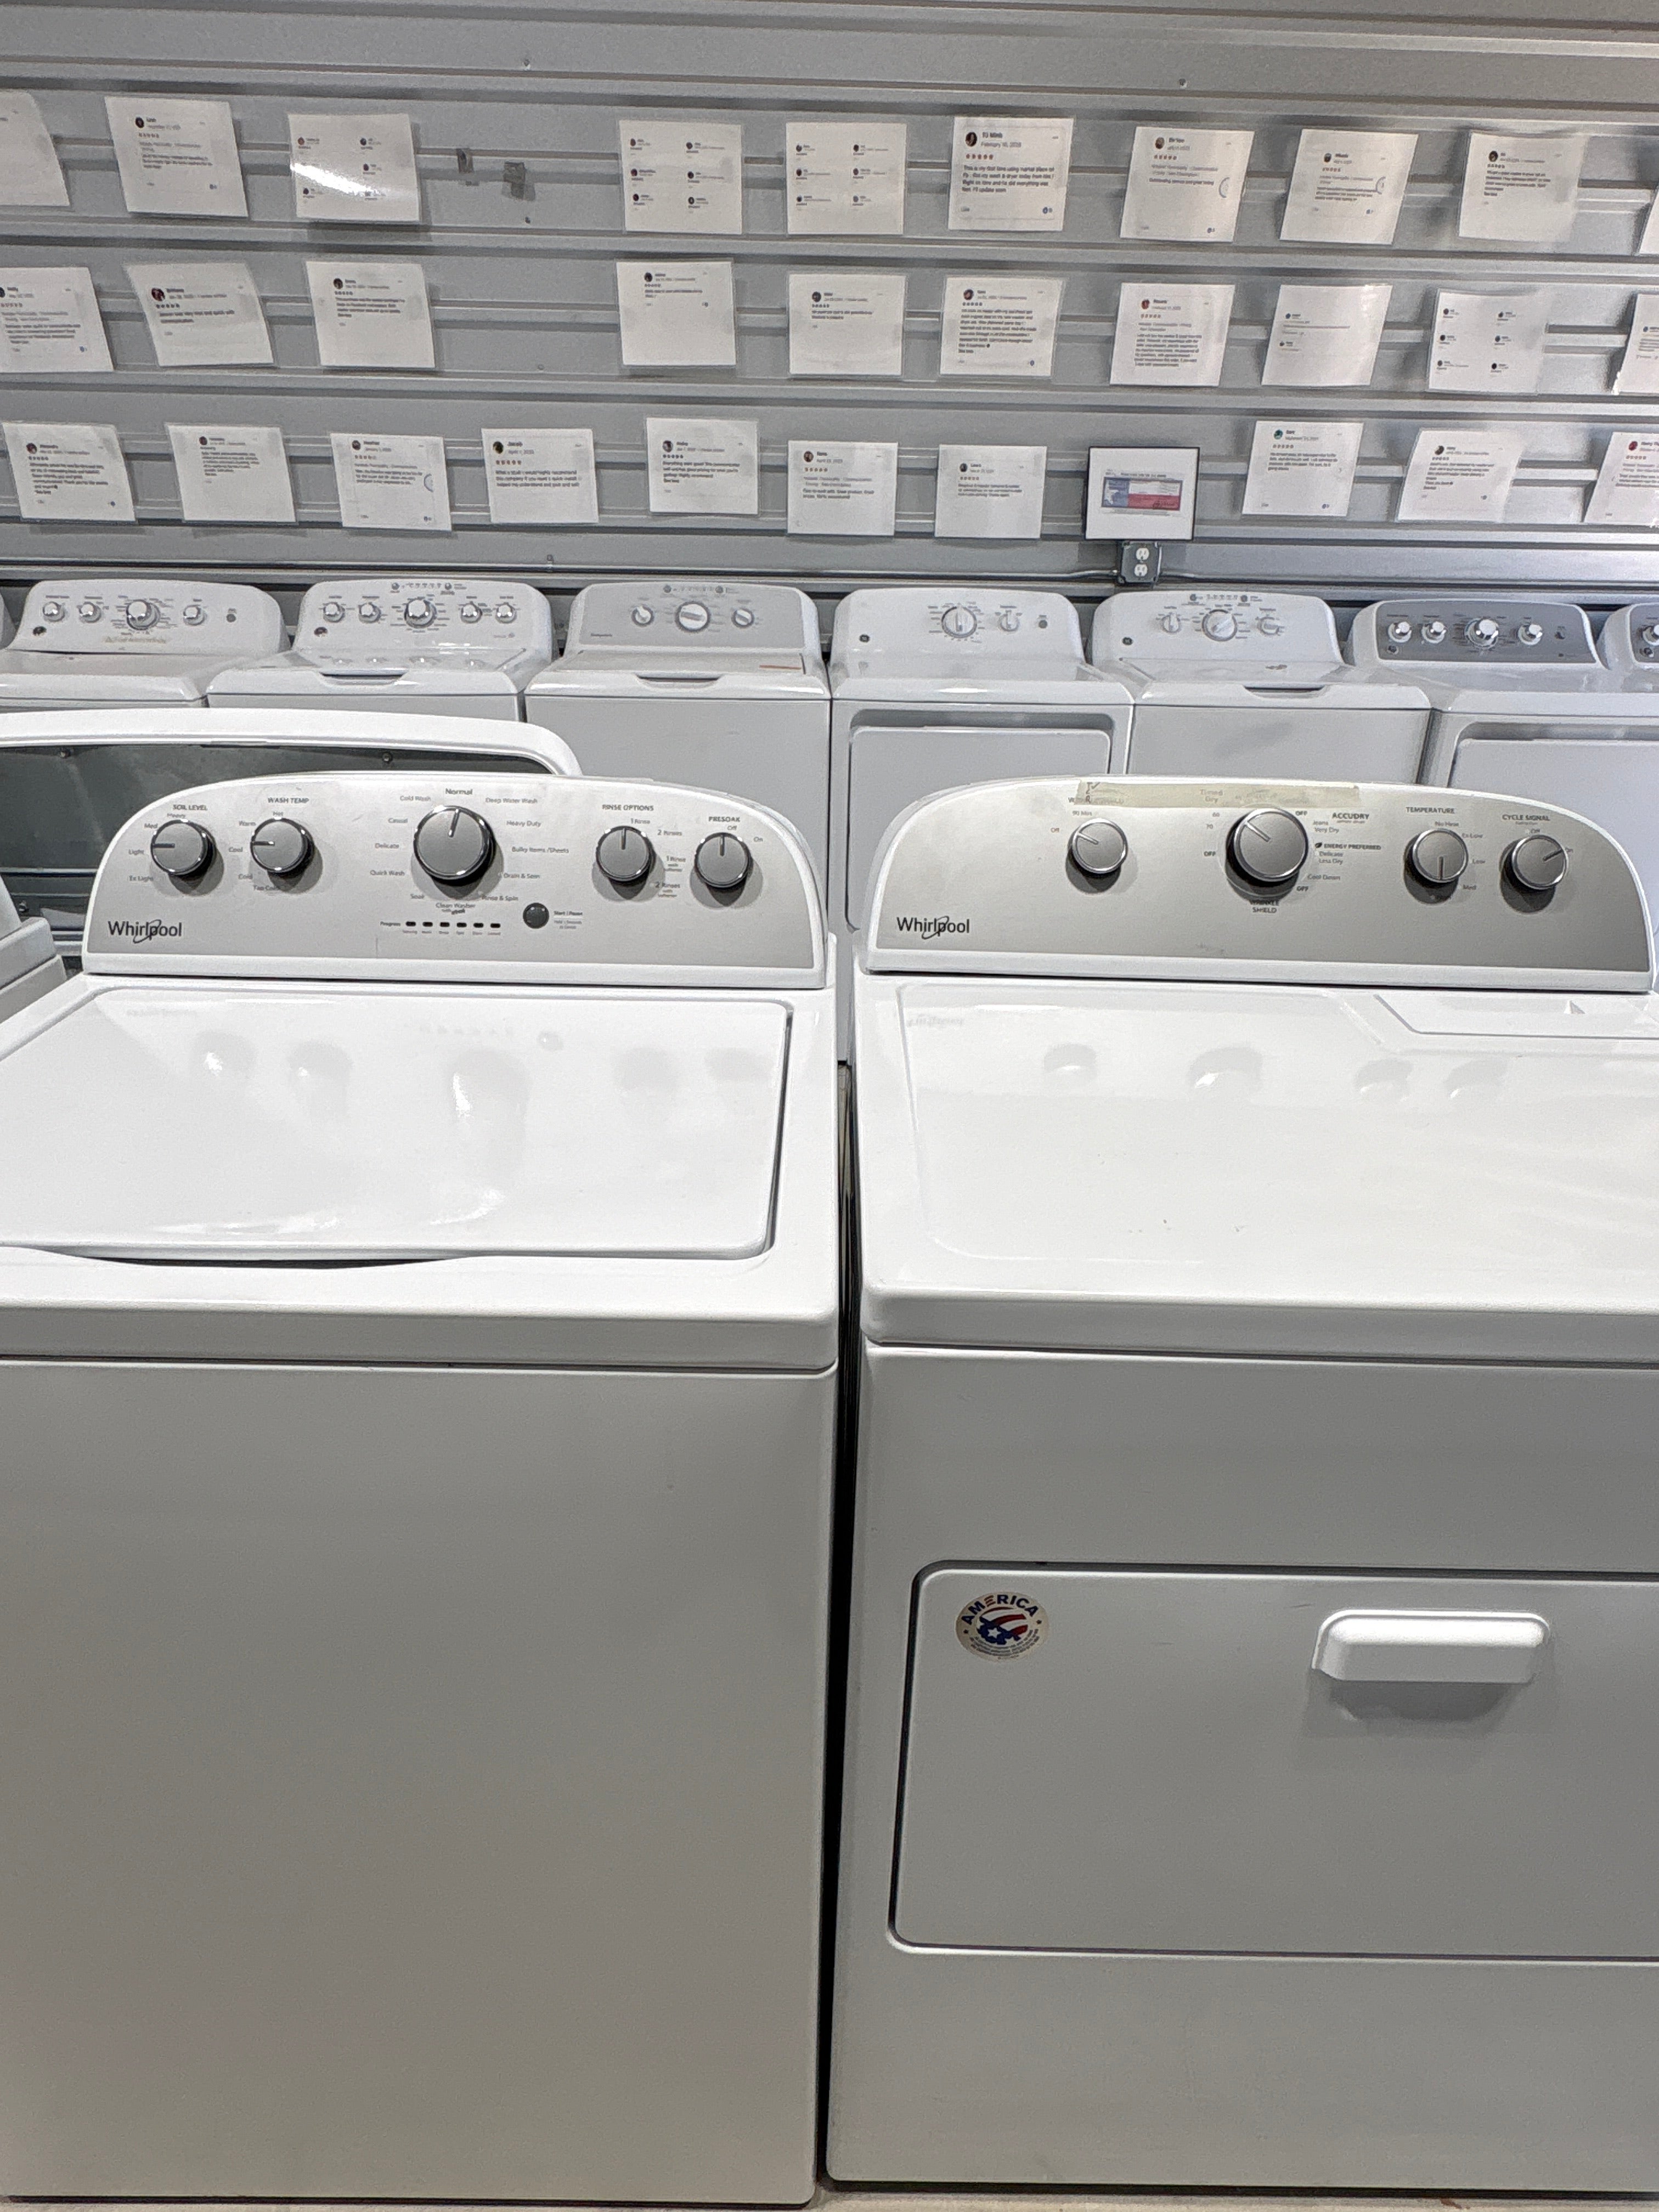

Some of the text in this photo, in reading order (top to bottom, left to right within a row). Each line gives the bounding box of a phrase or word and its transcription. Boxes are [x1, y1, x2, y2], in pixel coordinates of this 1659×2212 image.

[108, 919, 182, 944] Whirlpool
[896, 916, 970, 939] Whirlpool
[961, 1594, 1039, 1626] AMERICA
